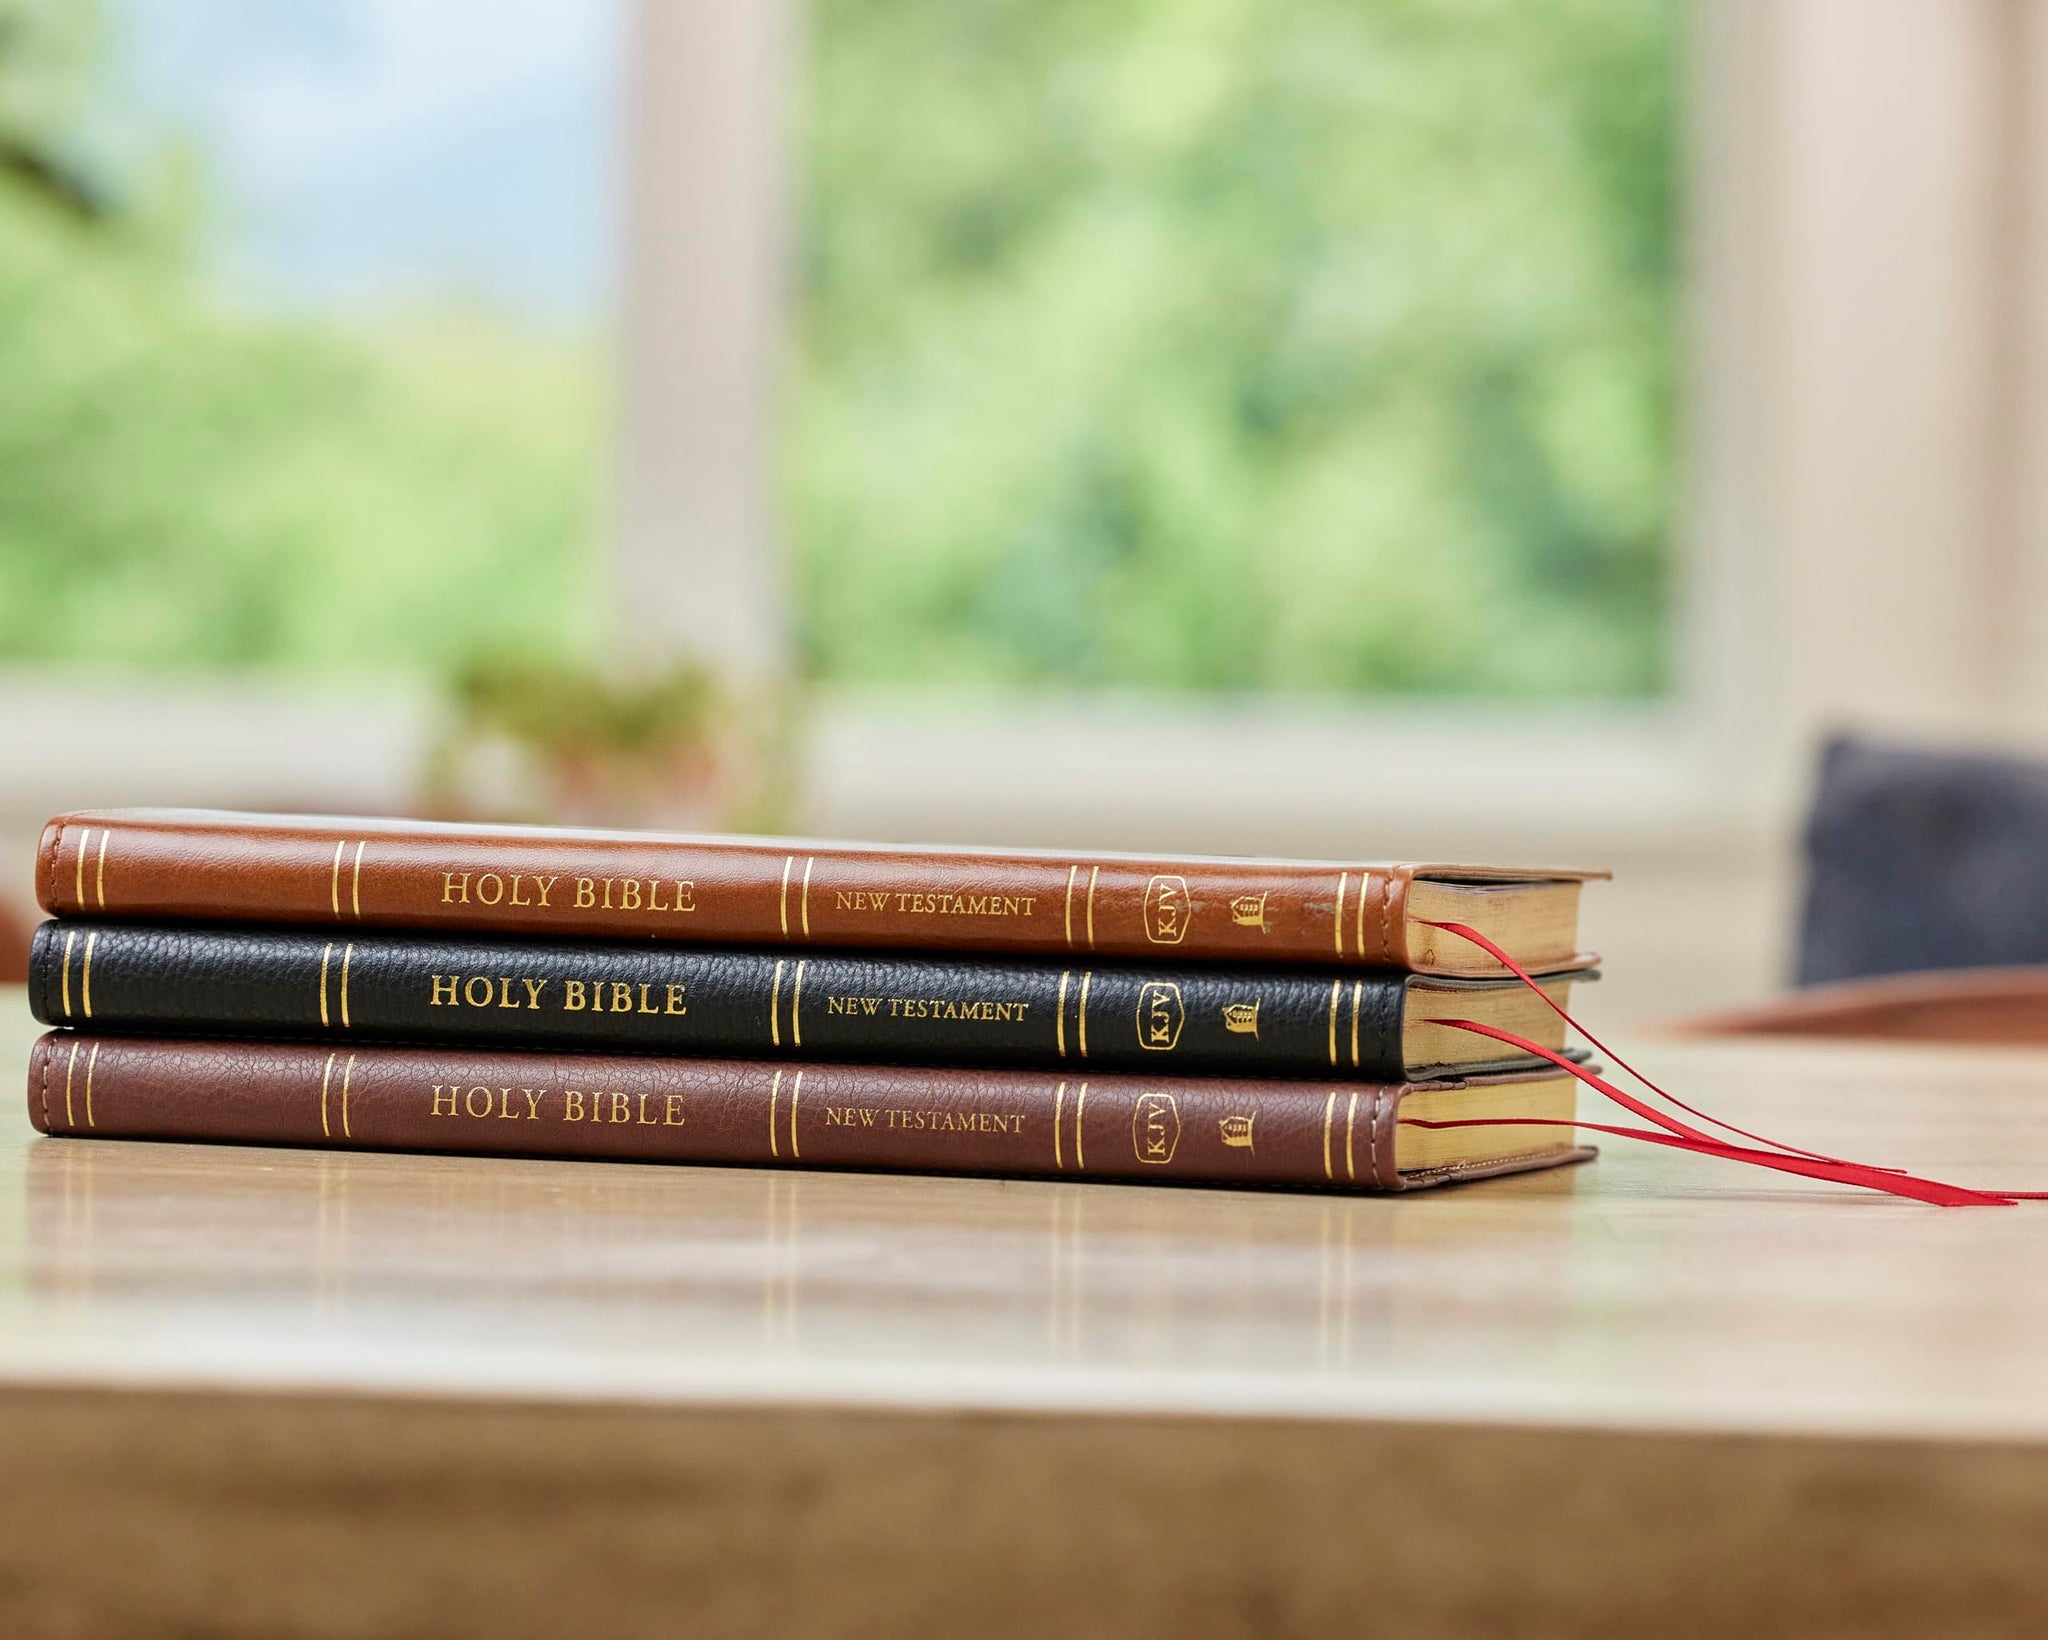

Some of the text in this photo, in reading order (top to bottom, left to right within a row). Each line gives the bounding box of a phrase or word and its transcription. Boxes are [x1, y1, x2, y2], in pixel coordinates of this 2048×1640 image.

[441, 873, 697, 913] HOLY BIBLE
[835, 891, 1036, 917] NEW TESTAMENT
[1158, 883, 1177, 937] KJV
[430, 975, 688, 1015] HOLY BIBLE
[827, 997, 1029, 1022] NEW TESTAMENT
[1151, 990, 1171, 1043] KJV
[431, 1085, 686, 1127] HOLY BIBLE
[825, 1107, 1025, 1134] NEW TESTAMENT
[1148, 1102, 1166, 1156] KJV
